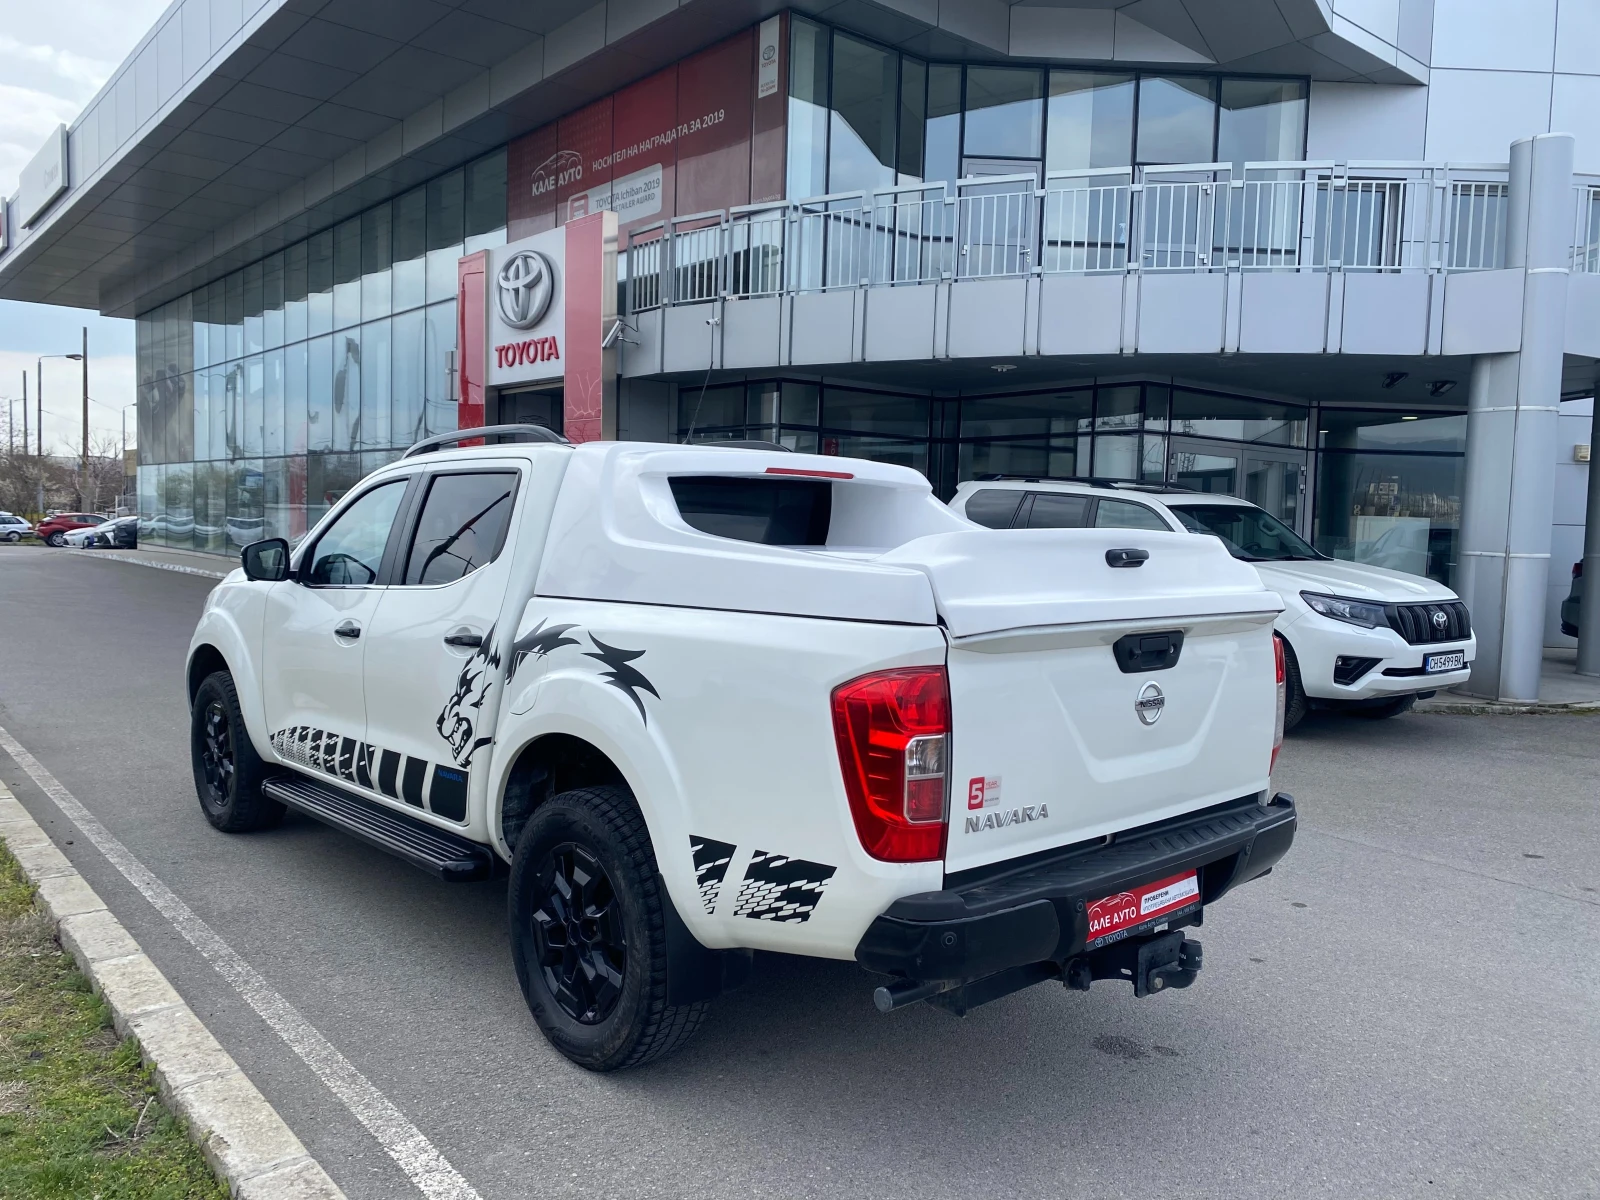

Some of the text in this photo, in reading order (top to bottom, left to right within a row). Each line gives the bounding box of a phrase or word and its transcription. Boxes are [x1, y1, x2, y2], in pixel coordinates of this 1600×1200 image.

[761, 58, 776, 68] TOYOTA
[593, 108, 725, 172] НОСИТЕЛ НА НАГРАДАТА ЗА 2019
[532, 165, 583, 196] КАЛЕ АУТО
[595, 177, 660, 209] TOYOTA Ichiban 2019
[494, 335, 560, 368] TOYOTA
[1140, 698, 1165, 708] NISSAN
[437, 769, 464, 782] NAVARA
[970, 782, 983, 804] 5
[964, 803, 1049, 834] NAVARA
[1112, 907, 1137, 924] АУТО
[1104, 930, 1129, 944] TOYOTA
